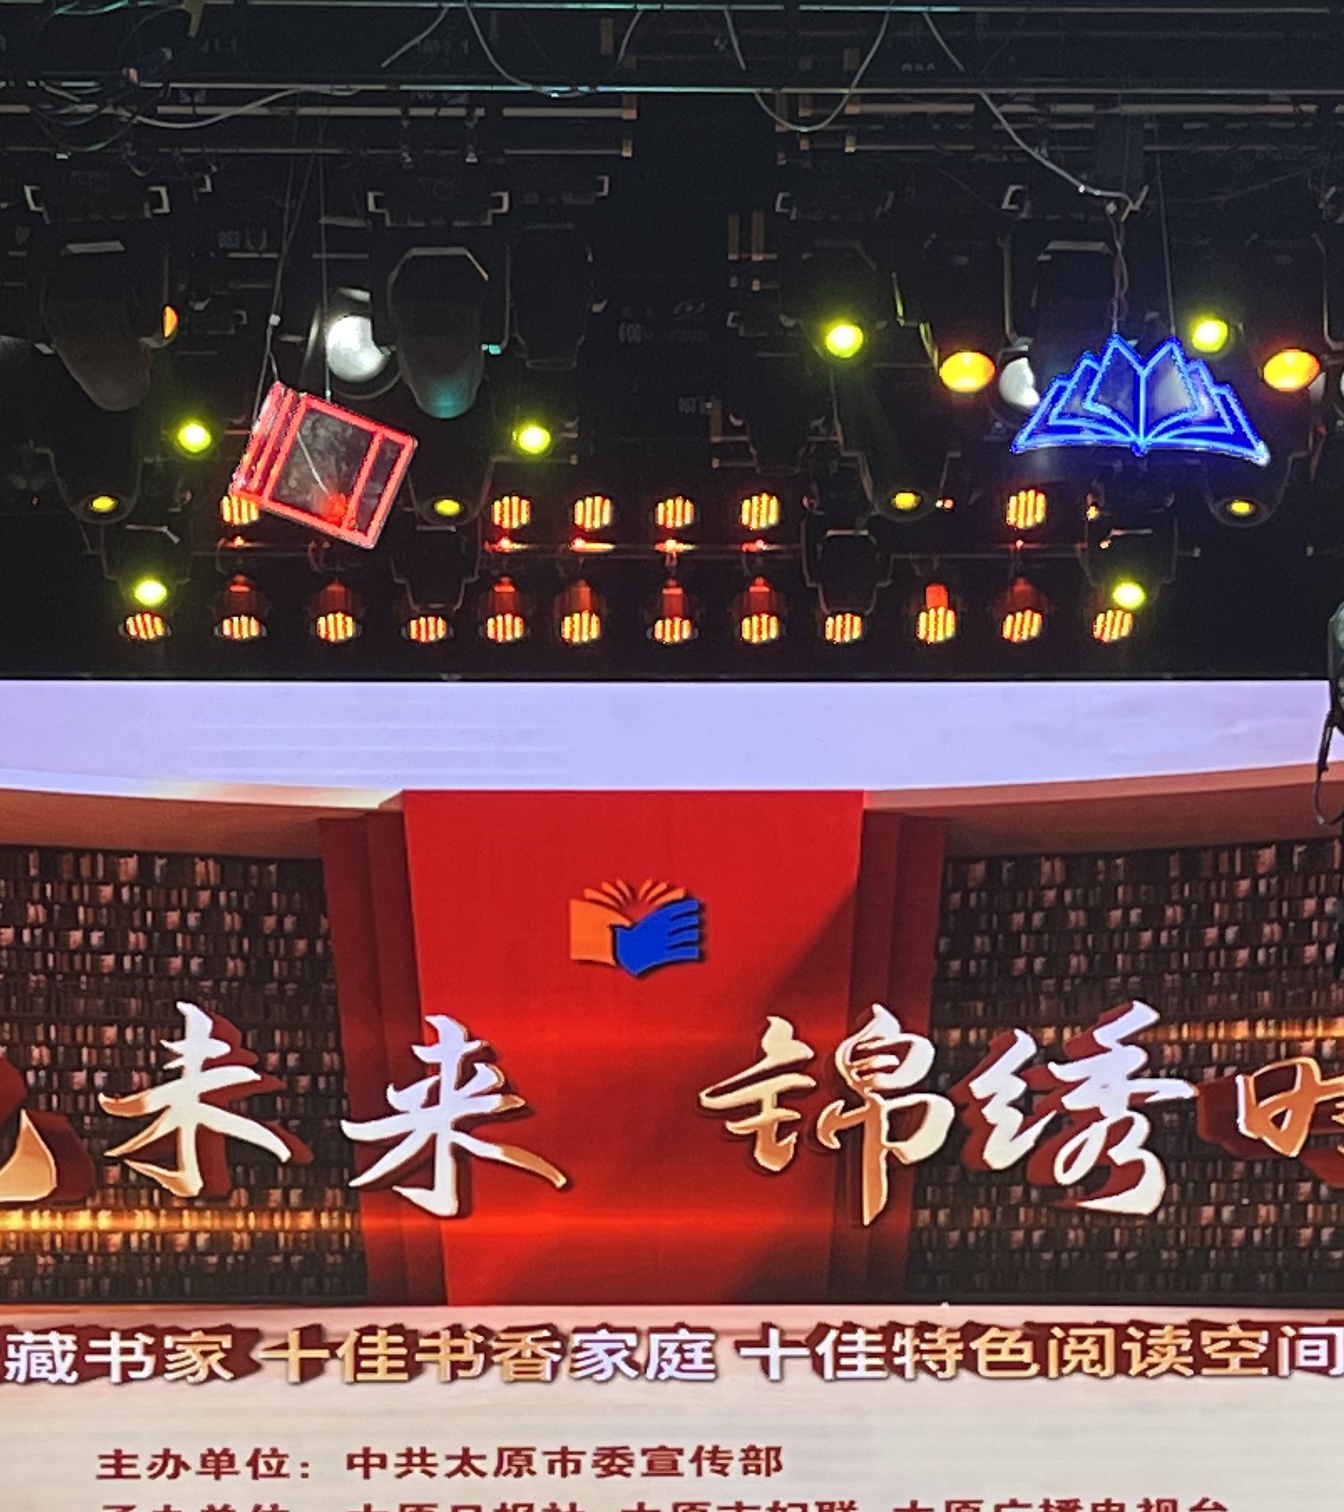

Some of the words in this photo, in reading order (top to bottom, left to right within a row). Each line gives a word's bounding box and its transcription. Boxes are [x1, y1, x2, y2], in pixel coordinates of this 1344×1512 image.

[259, 1327, 718, 1384] 十佳书香家庭
[346, 1444, 785, 1480] 中共太原市委宣传部
